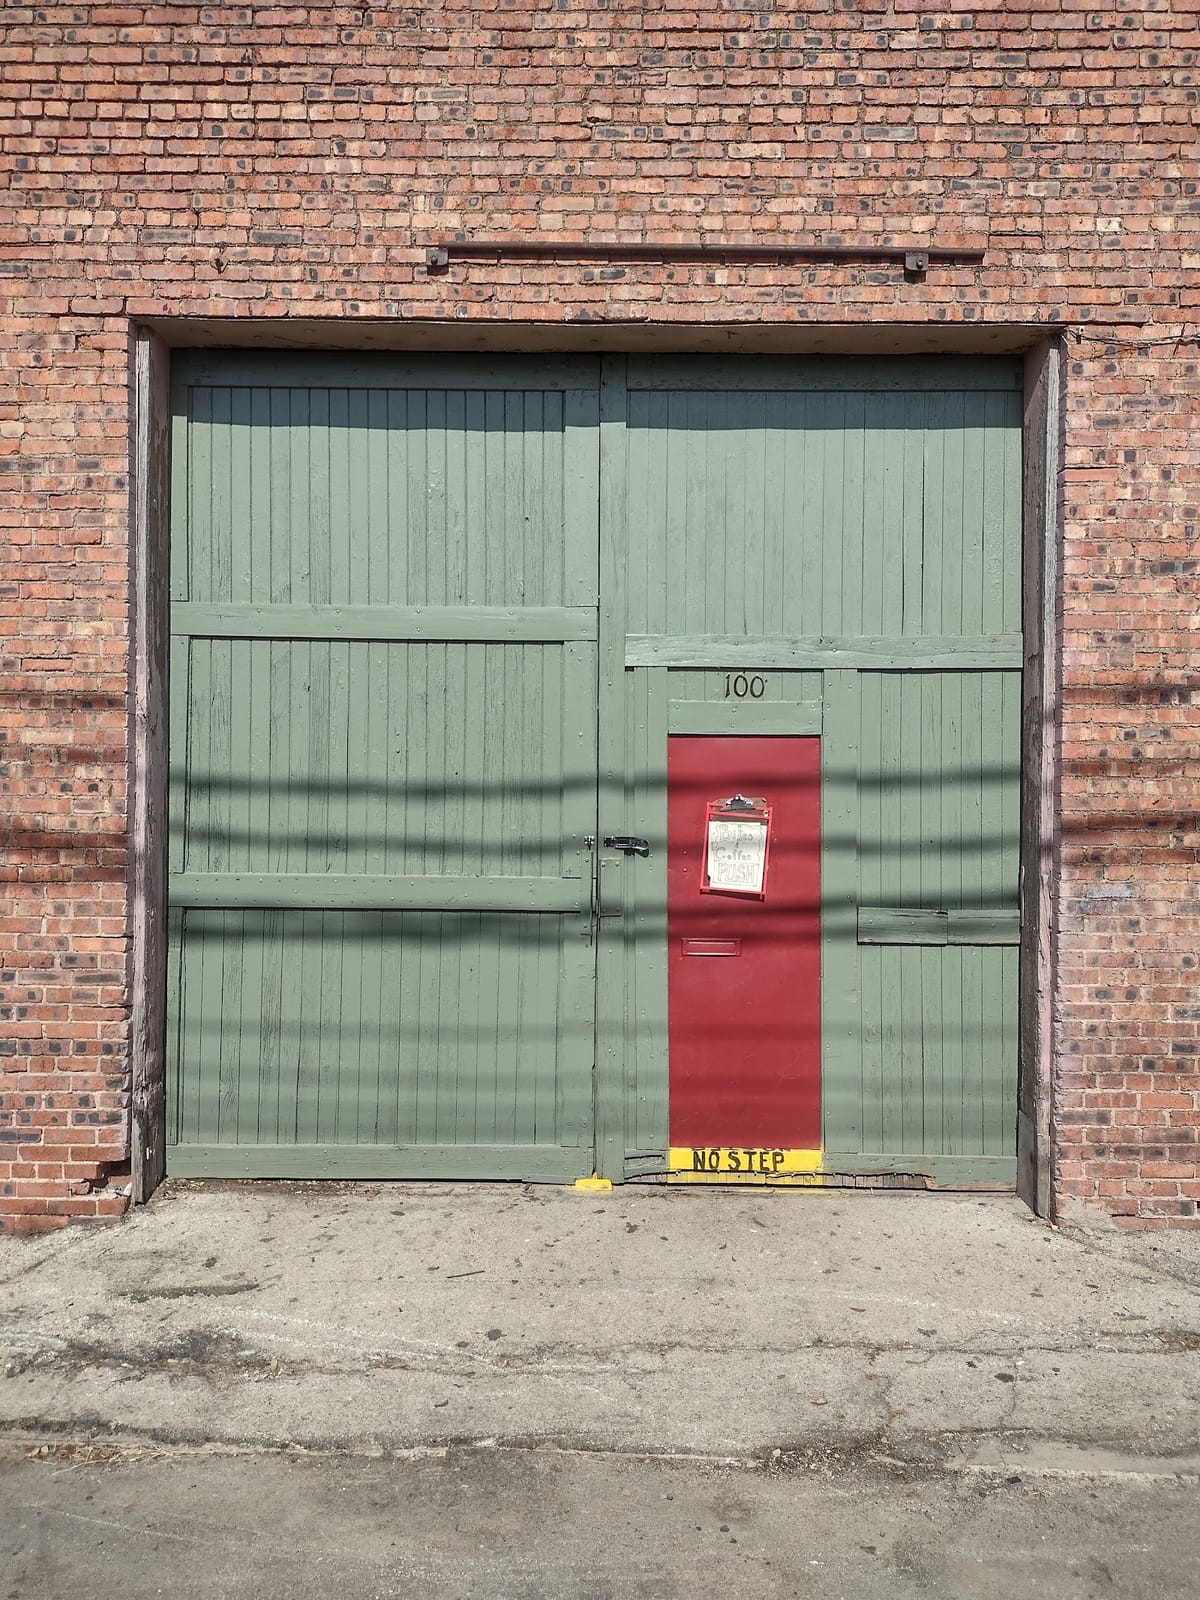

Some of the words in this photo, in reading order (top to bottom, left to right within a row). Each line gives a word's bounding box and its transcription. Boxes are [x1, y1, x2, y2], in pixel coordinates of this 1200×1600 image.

[724, 673, 765, 699] 100
[717, 863, 755, 883] PUSH
[692, 1151, 721, 1171] NO
[727, 1151, 785, 1172] STEP
